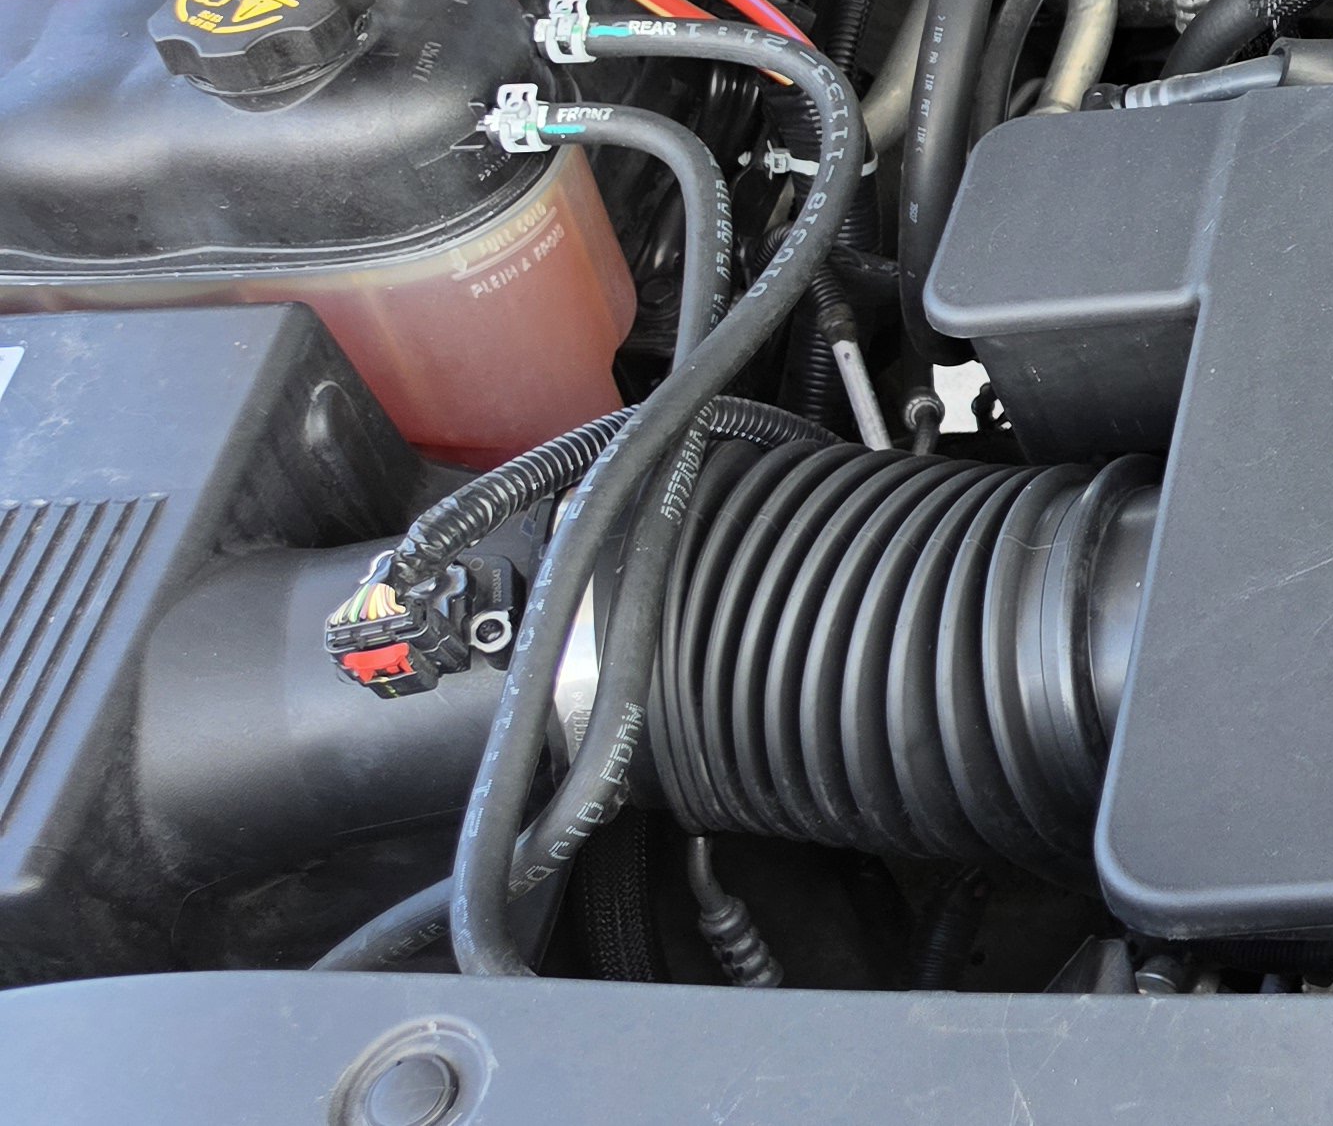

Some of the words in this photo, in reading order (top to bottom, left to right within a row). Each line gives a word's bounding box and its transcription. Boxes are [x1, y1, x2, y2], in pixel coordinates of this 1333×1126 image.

[629, 21, 676, 36] REAR
[557, 107, 614, 123] FRONT
[517, 201, 547, 233] COLD
[470, 265, 519, 299] PLEIN
